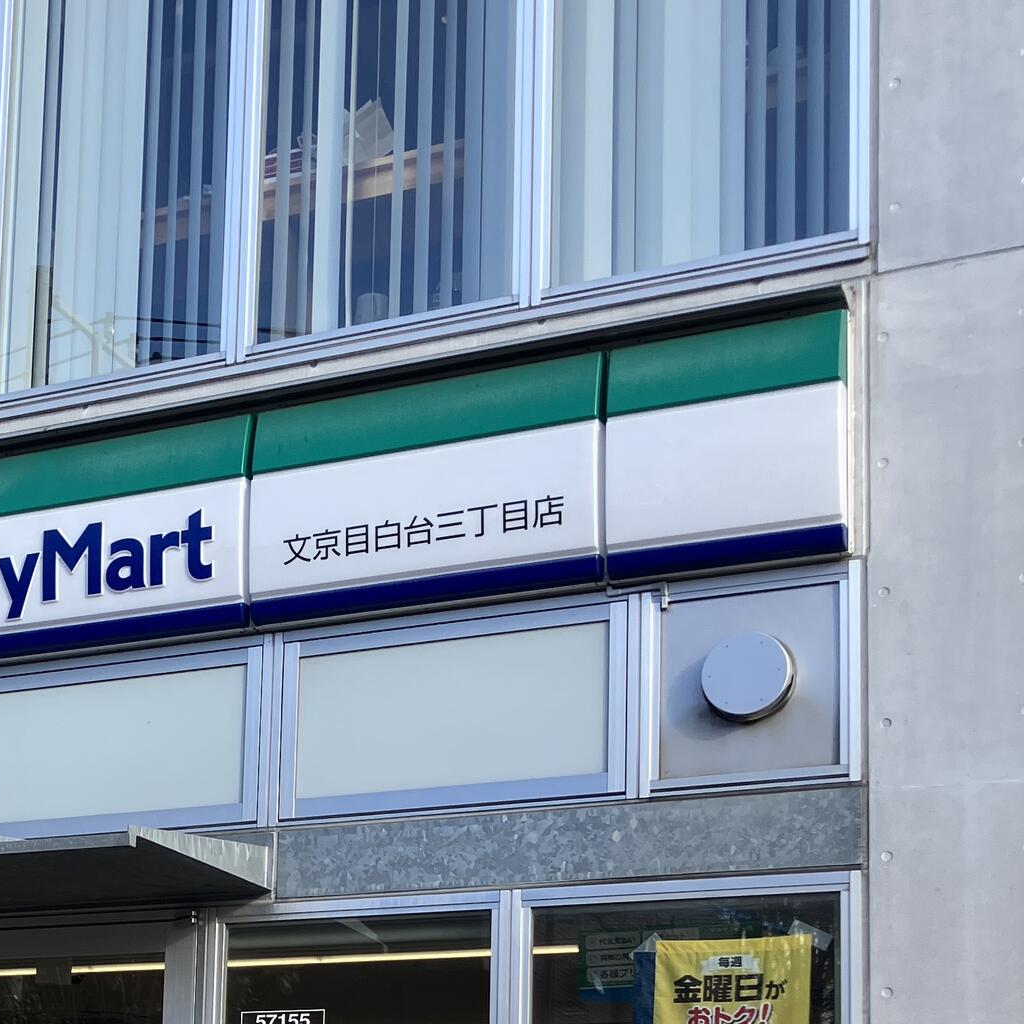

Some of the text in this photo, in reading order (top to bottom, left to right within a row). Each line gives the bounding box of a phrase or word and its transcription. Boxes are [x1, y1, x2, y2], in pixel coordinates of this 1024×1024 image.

[283, 495, 564, 565] 文京目白台三丁目店
[718, 956, 743, 968] 毎週
[673, 974, 787, 1003] 金曜日が
